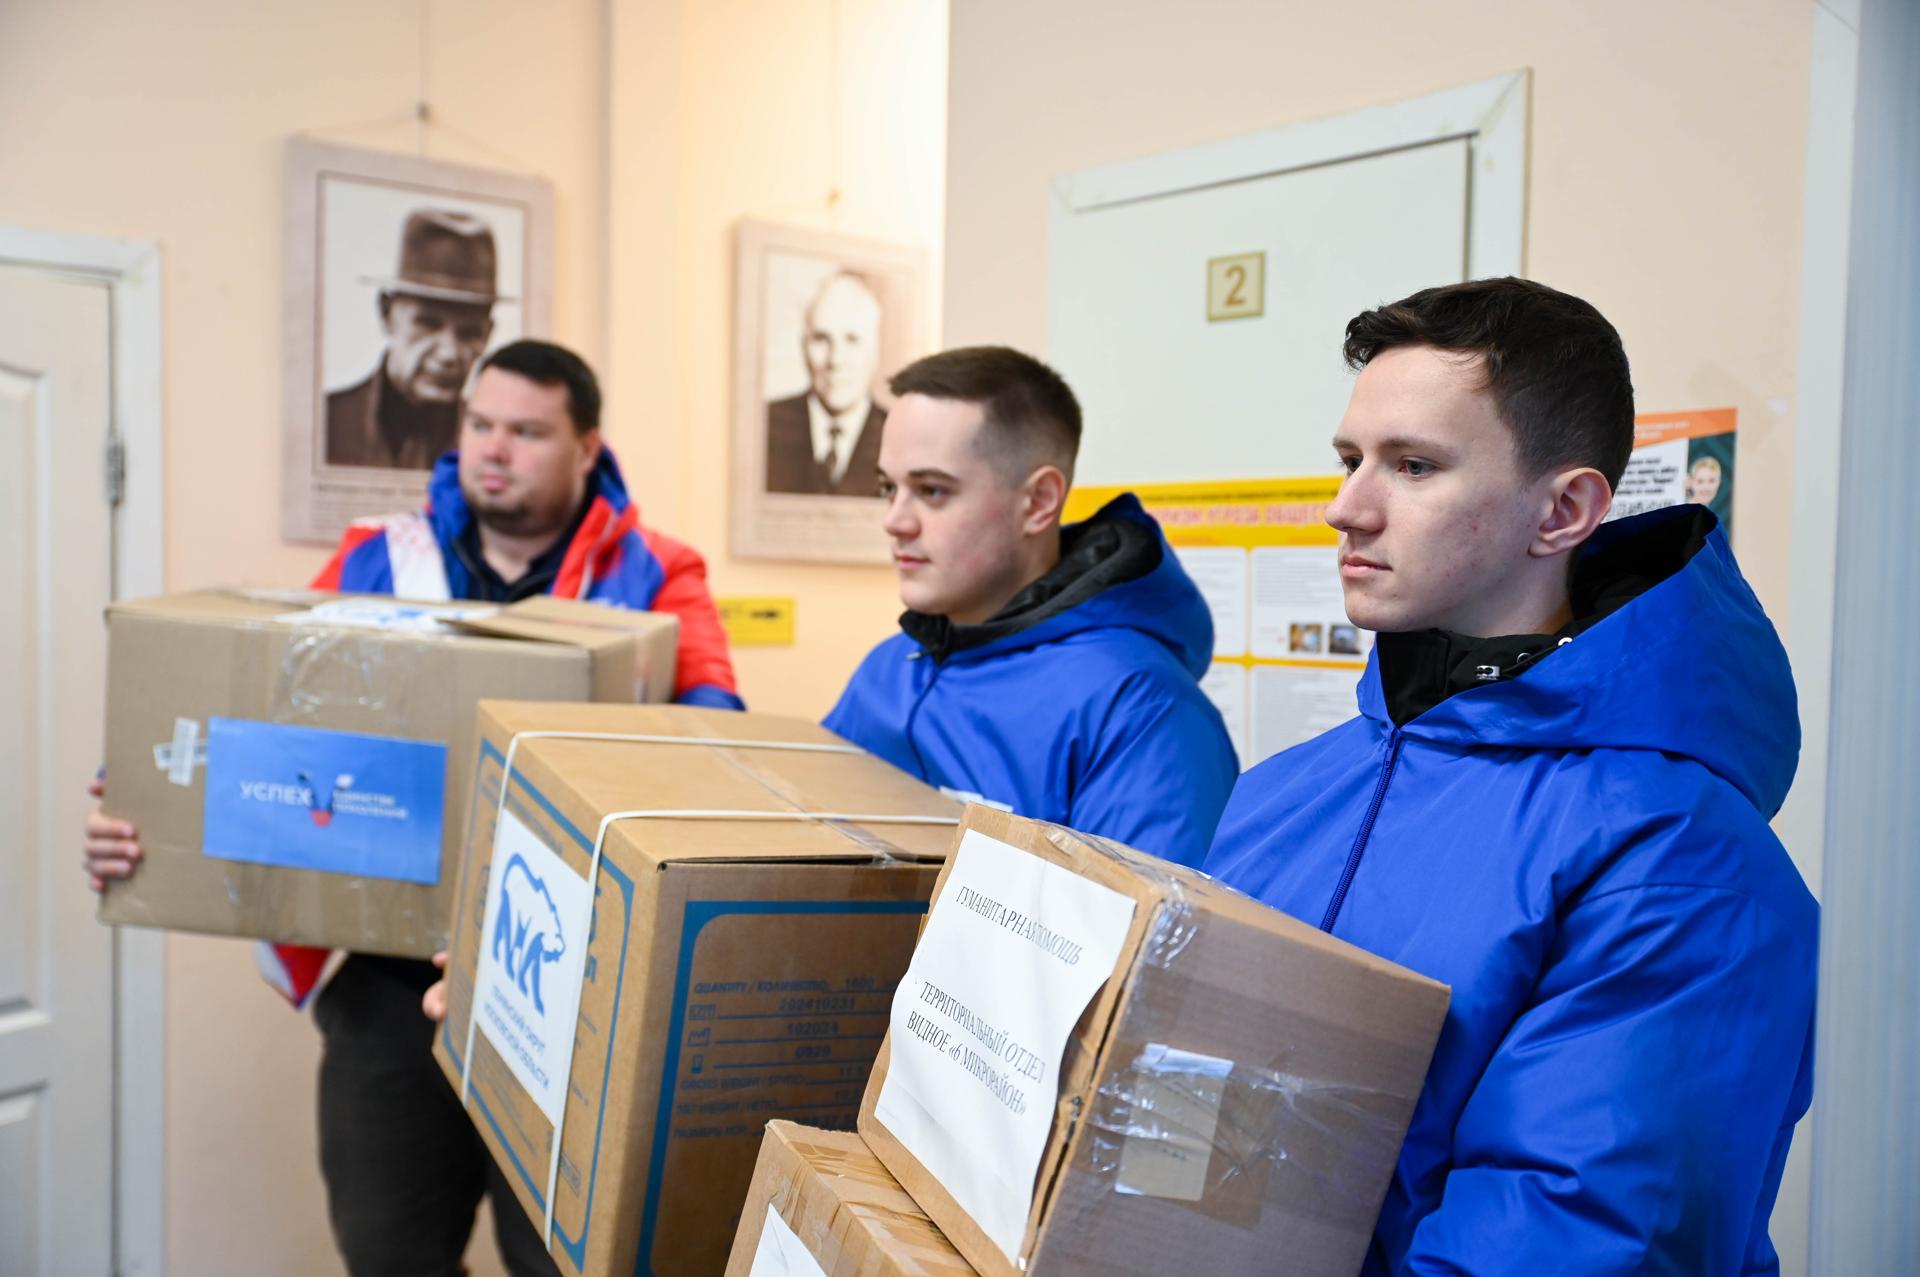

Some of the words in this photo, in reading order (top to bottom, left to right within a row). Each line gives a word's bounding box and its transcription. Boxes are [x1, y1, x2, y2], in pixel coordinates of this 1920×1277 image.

[1225, 265, 1246, 306] 2
[239, 780, 312, 806] УСПЕХ
[907, 1011, 952, 1053] ВИДНОЕ
[920, 981, 1008, 1056] ТЕРРИТОРИАЛЬНЫЙ
